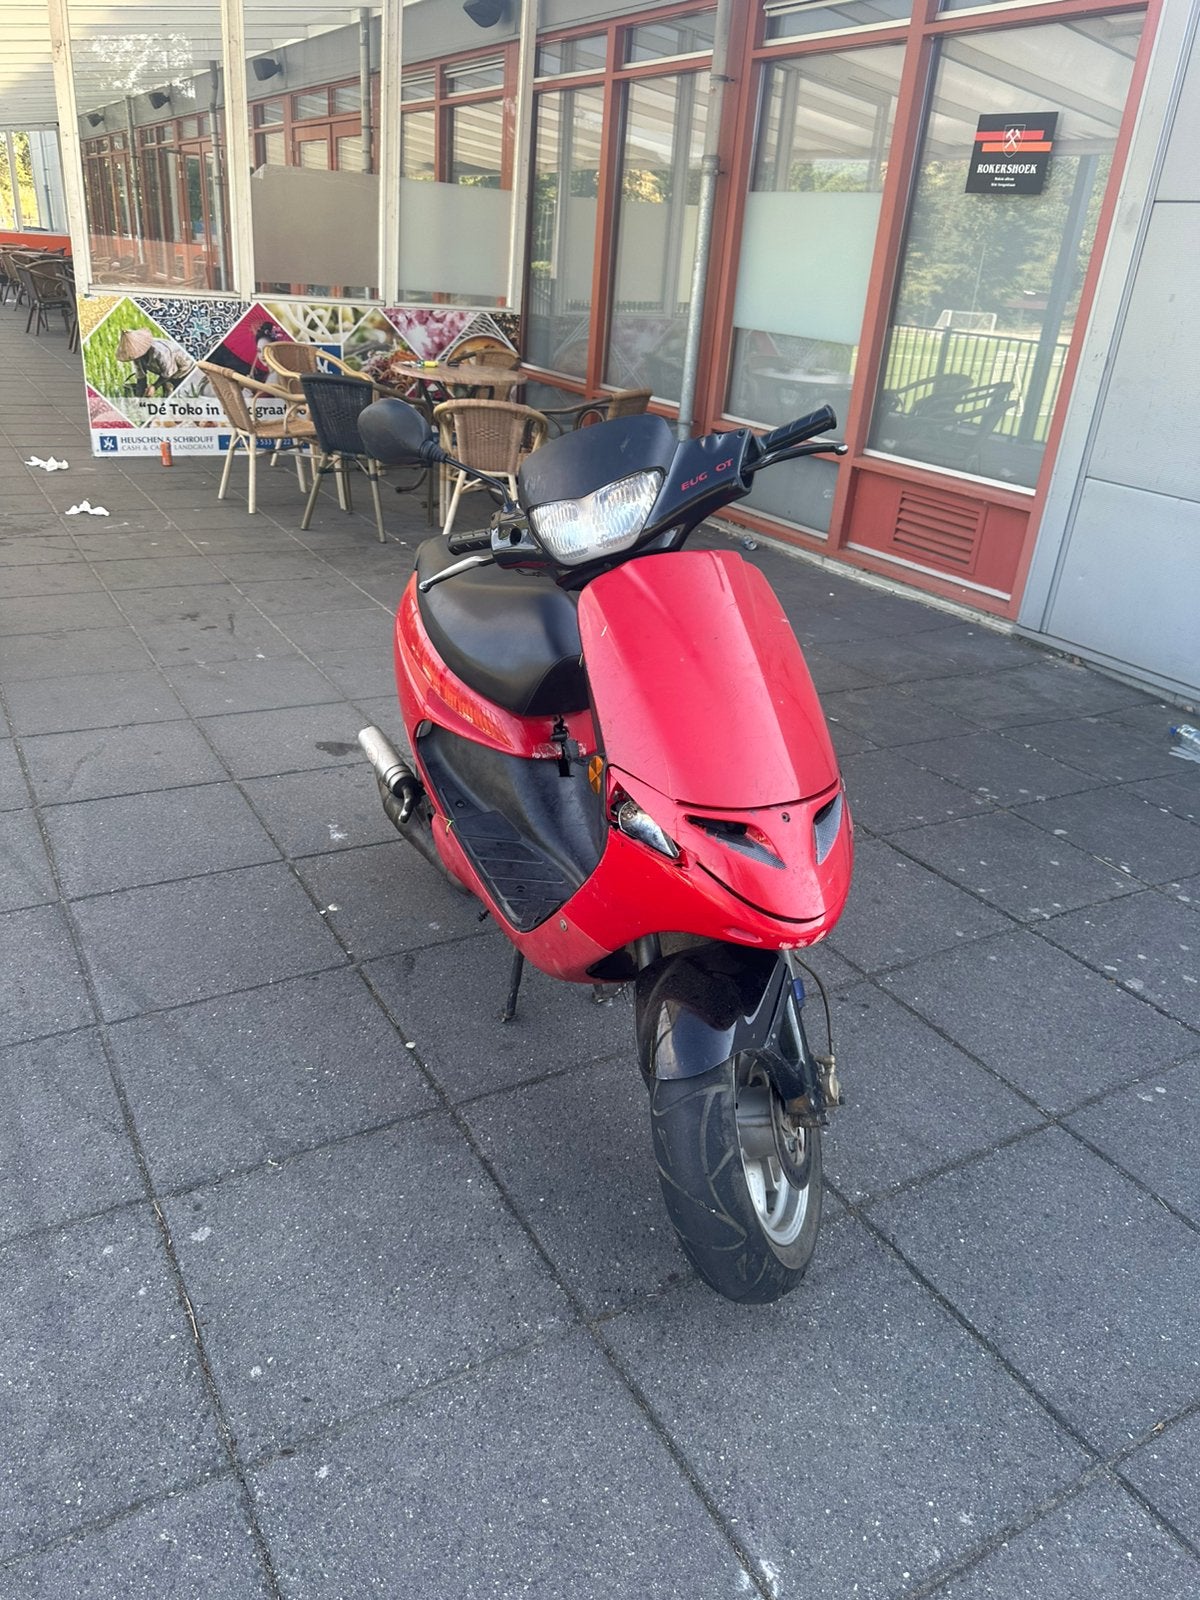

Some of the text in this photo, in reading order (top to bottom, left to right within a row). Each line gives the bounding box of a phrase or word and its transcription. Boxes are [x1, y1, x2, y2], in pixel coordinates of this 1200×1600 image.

[976, 163, 1037, 174] ROKERSHOEK
[169, 403, 203, 415] Toko
[206, 403, 220, 415] in
[121, 436, 163, 444] HEUSCHEN
[173, 435, 213, 443] SCHROUFF
[681, 458, 734, 491] EUG OT
